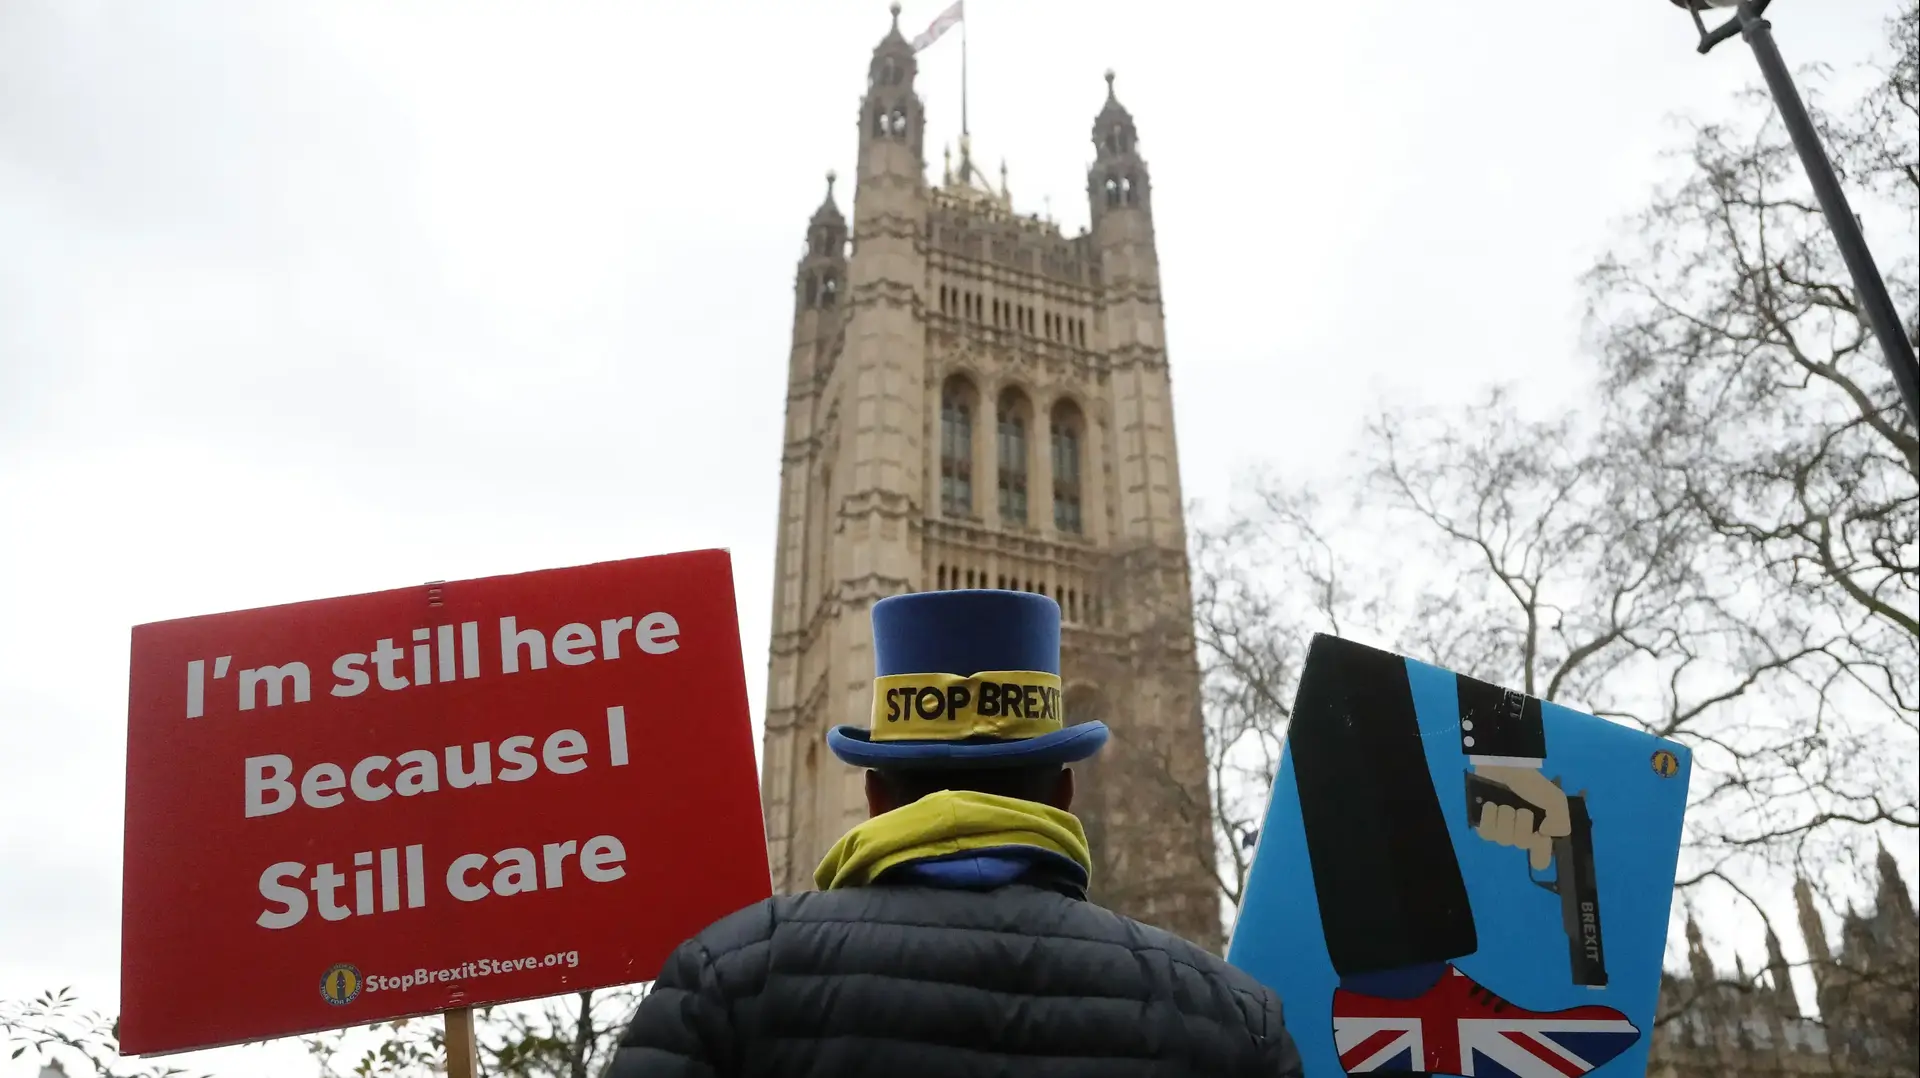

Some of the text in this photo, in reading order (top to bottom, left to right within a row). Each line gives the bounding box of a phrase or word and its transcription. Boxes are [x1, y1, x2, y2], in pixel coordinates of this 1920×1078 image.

[187, 612, 680, 718] I’m still here
[887, 681, 1060, 722] STOP BREXIT
[245, 706, 628, 818] Because I
[256, 835, 626, 929] Still care
[1581, 902, 1599, 963] BREXIT
[366, 950, 579, 993] StopBrexitSteve.org
